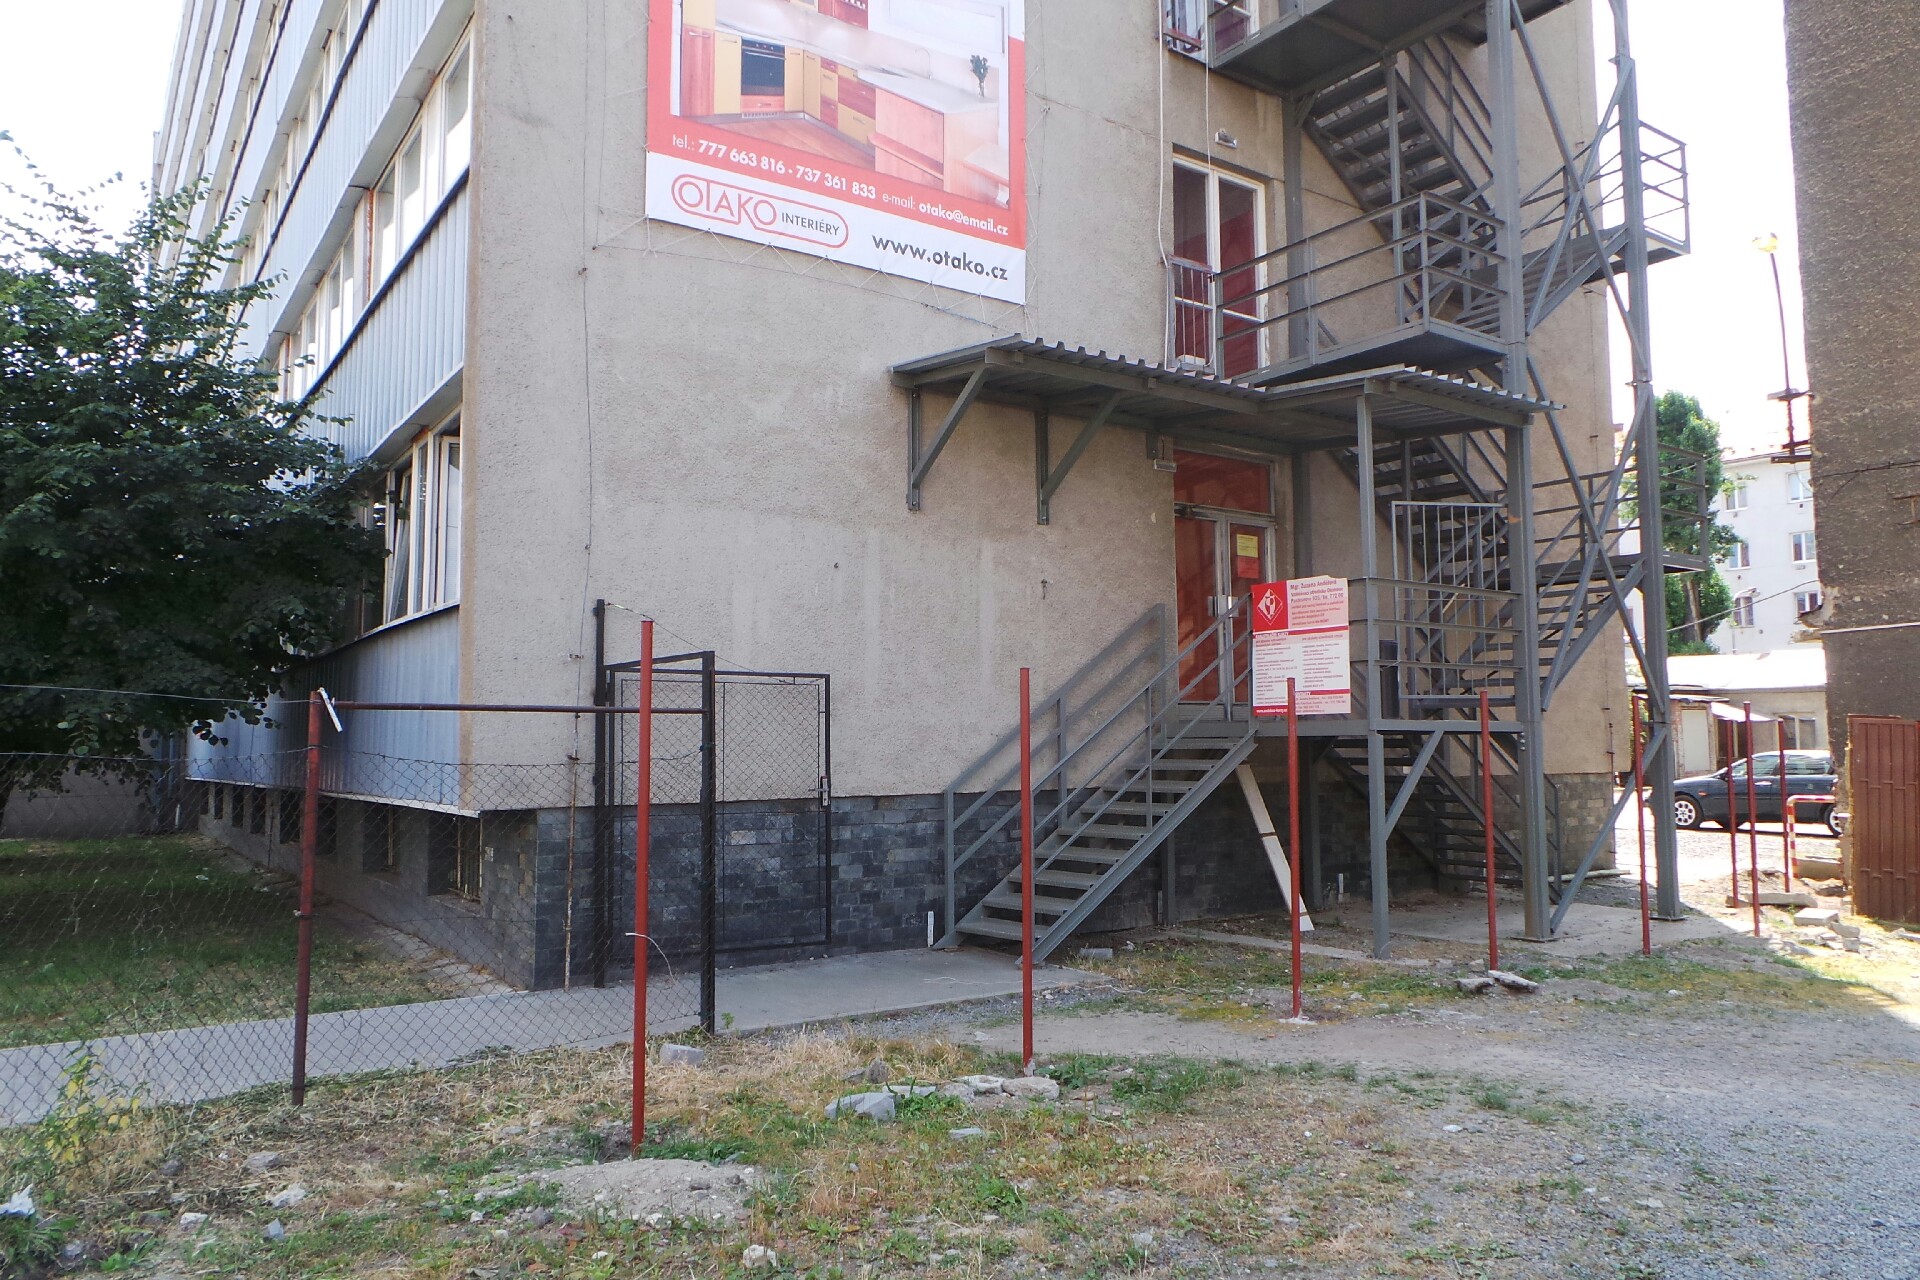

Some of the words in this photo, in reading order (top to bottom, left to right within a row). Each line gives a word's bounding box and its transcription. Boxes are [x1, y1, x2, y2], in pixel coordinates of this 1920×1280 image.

[672, 133, 695, 151] tel.:
[698, 139, 728, 158] 777
[729, 148, 757, 167] 663
[760, 155, 786, 174] 816
[795, 164, 821, 183] 737
[823, 172, 847, 191] 361
[851, 181, 876, 199] 833
[882, 192, 916, 210] e-mail:
[918, 202, 1009, 236] otako@email.cz
[678, 179, 777, 226] OTAKO
[781, 211, 840, 236] INTERIÉRY
[871, 234, 1008, 281] www.otako.cz
